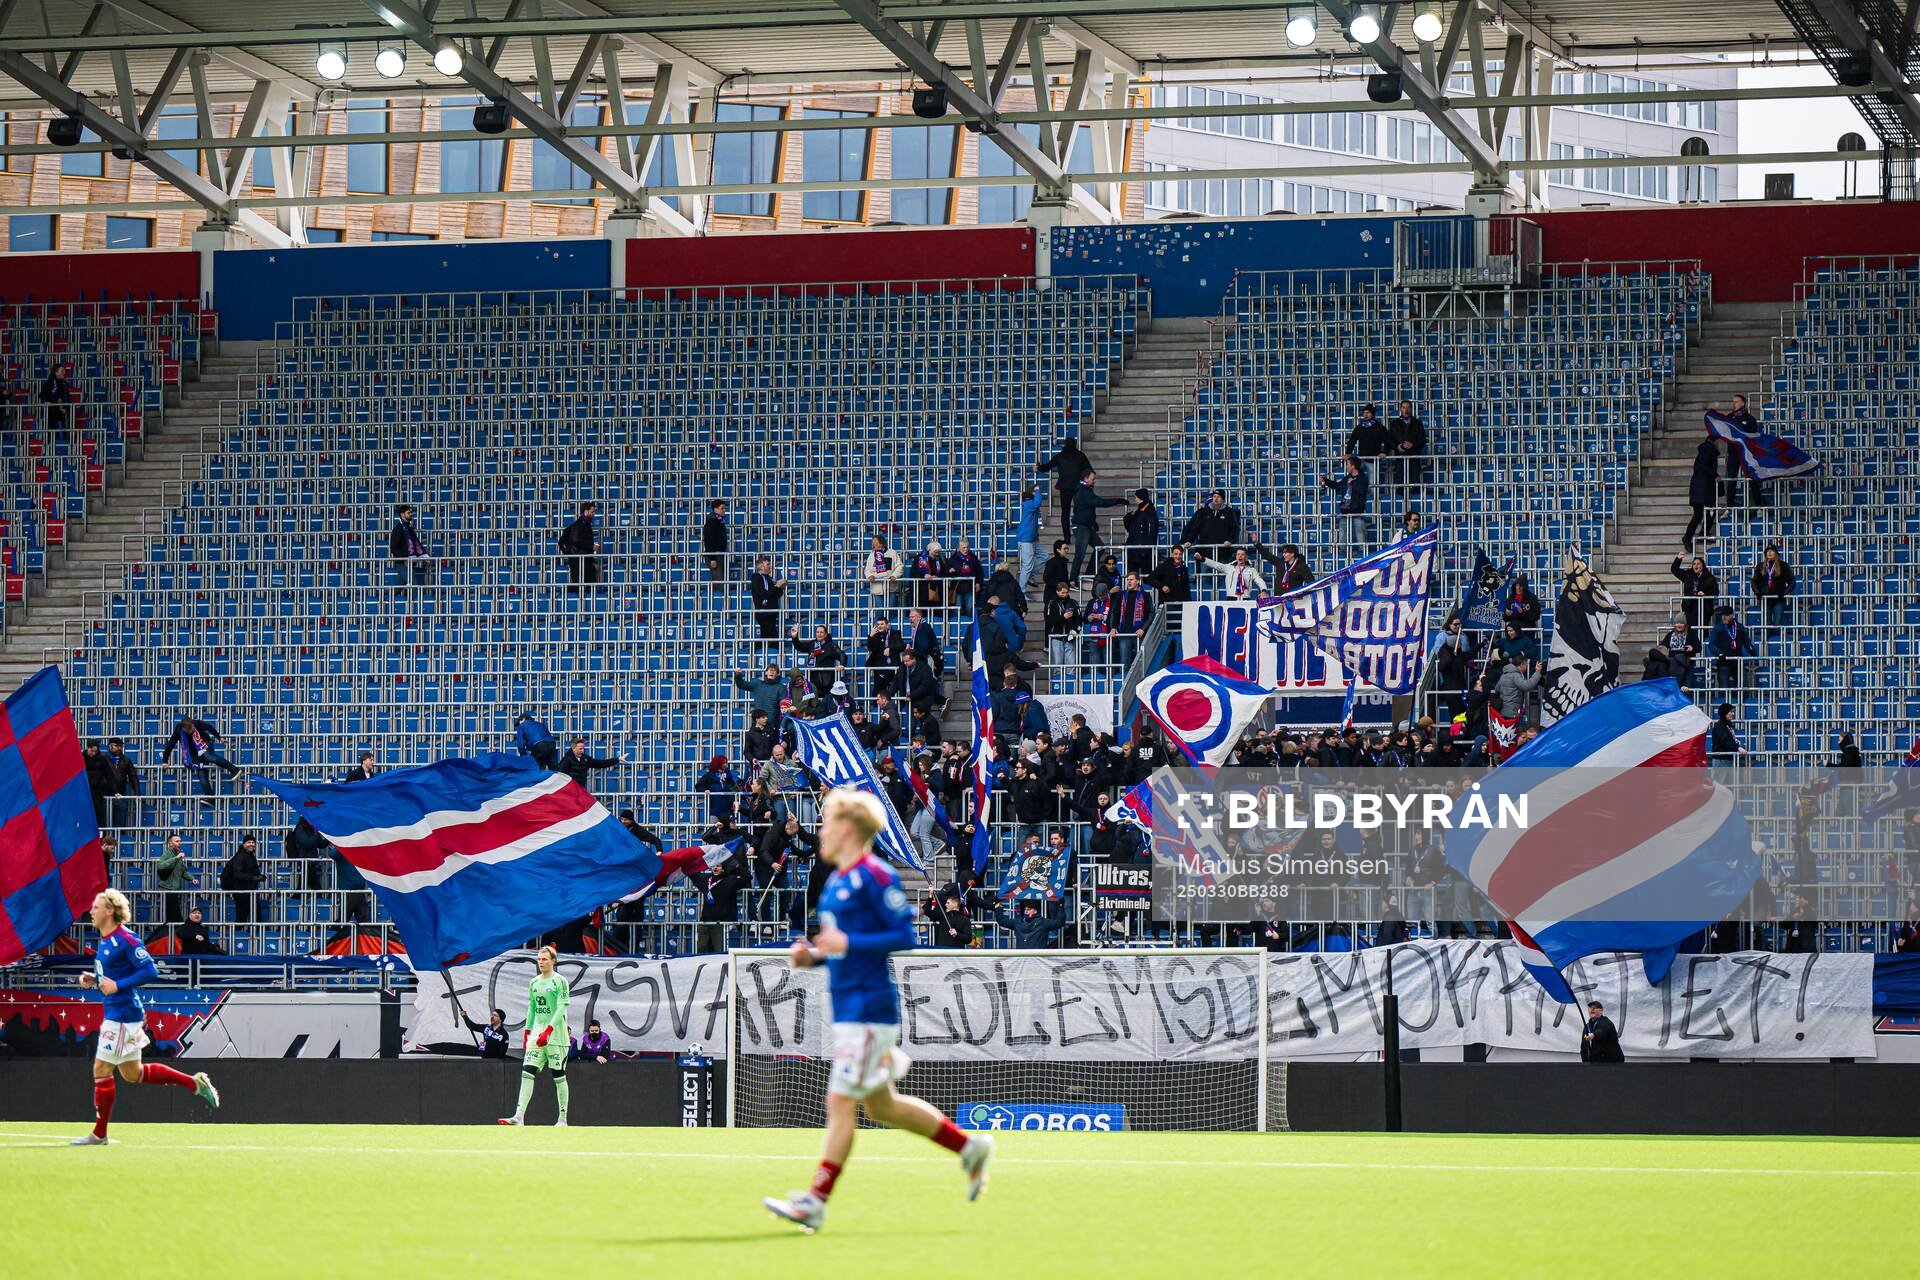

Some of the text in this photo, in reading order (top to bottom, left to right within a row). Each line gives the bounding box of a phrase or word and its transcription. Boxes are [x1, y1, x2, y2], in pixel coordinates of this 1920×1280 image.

[1139, 748, 1153, 758] SLO
[1098, 864, 1153, 889] Ultras,
[1105, 896, 1151, 910] kriminelle
[888, 941, 1819, 1049] EDLEMSDEMOKRATIET!
[683, 1071, 699, 1128] SELECT
[1020, 1113, 1112, 1131] OBOS
